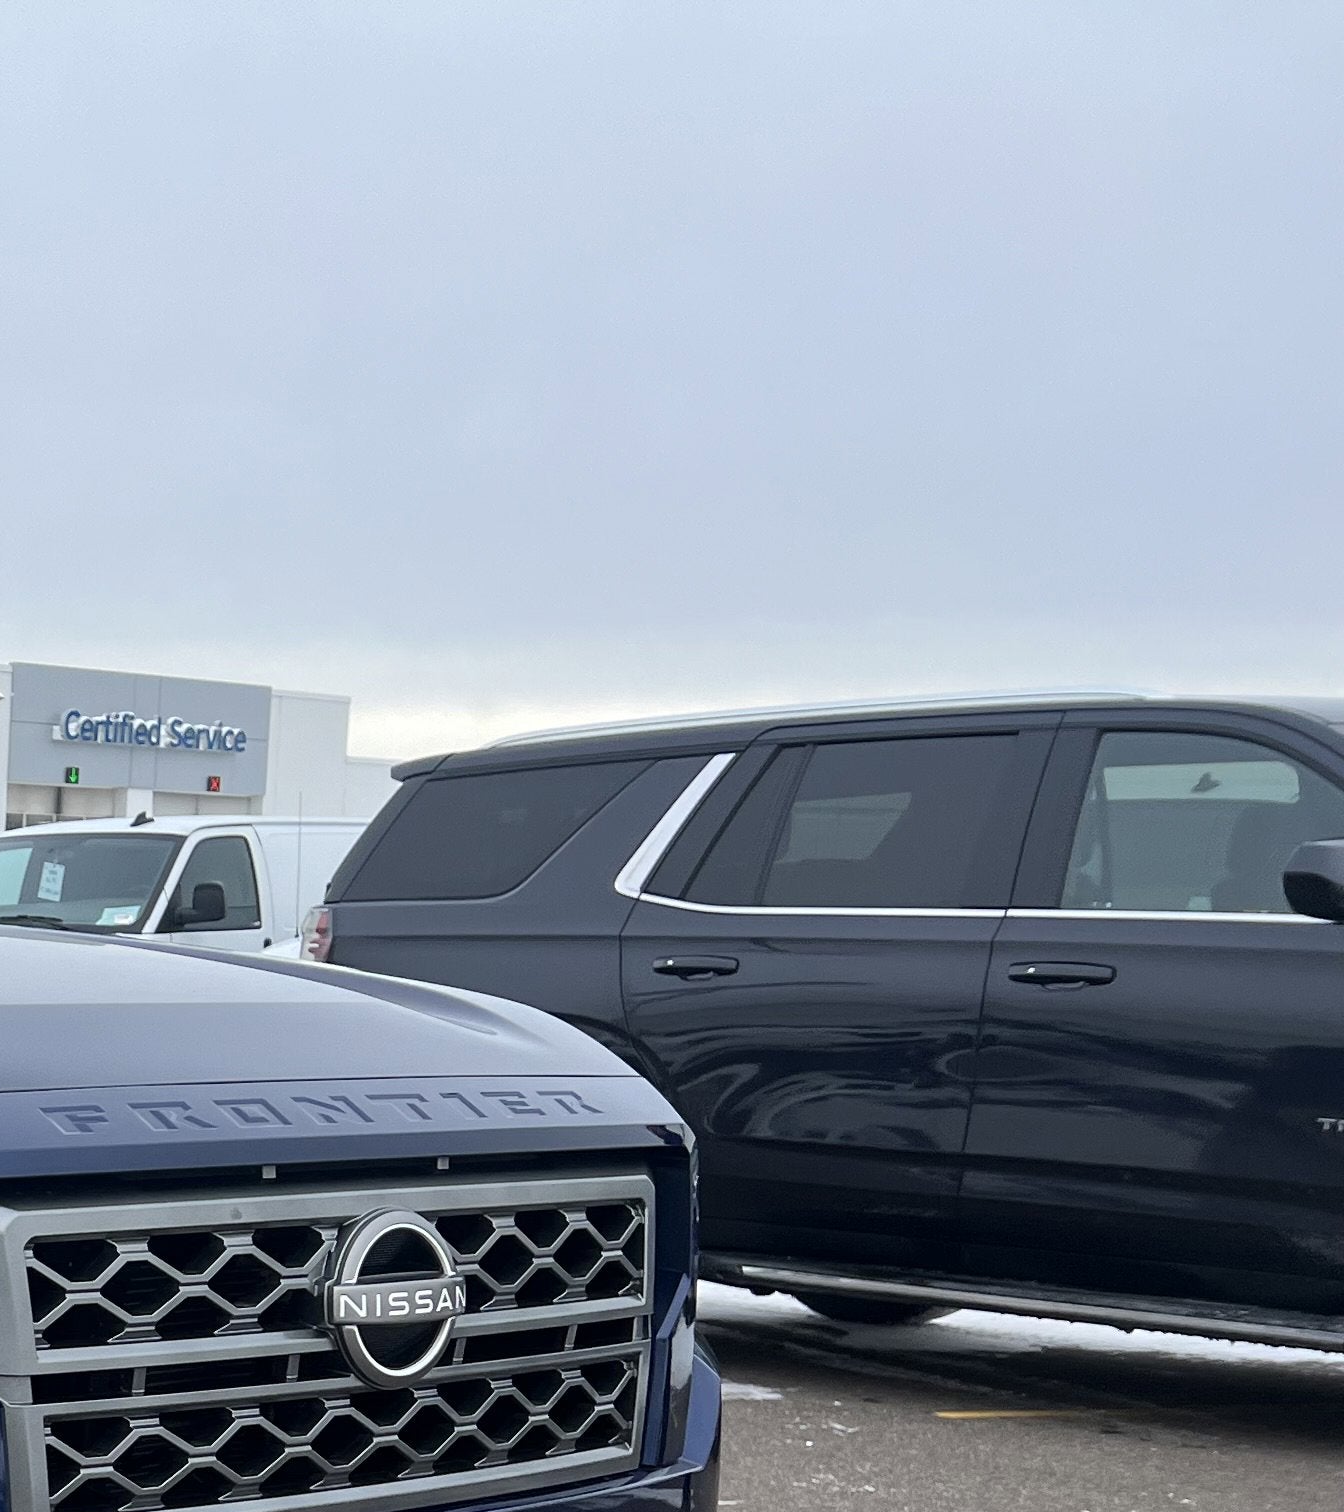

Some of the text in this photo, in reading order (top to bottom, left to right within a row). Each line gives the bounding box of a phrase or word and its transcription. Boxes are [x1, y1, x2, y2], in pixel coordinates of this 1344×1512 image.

[64, 709, 248, 753] Certified Service
[39, 1089, 605, 1135] FRONTIER
[339, 1284, 467, 1319] NISSAN
